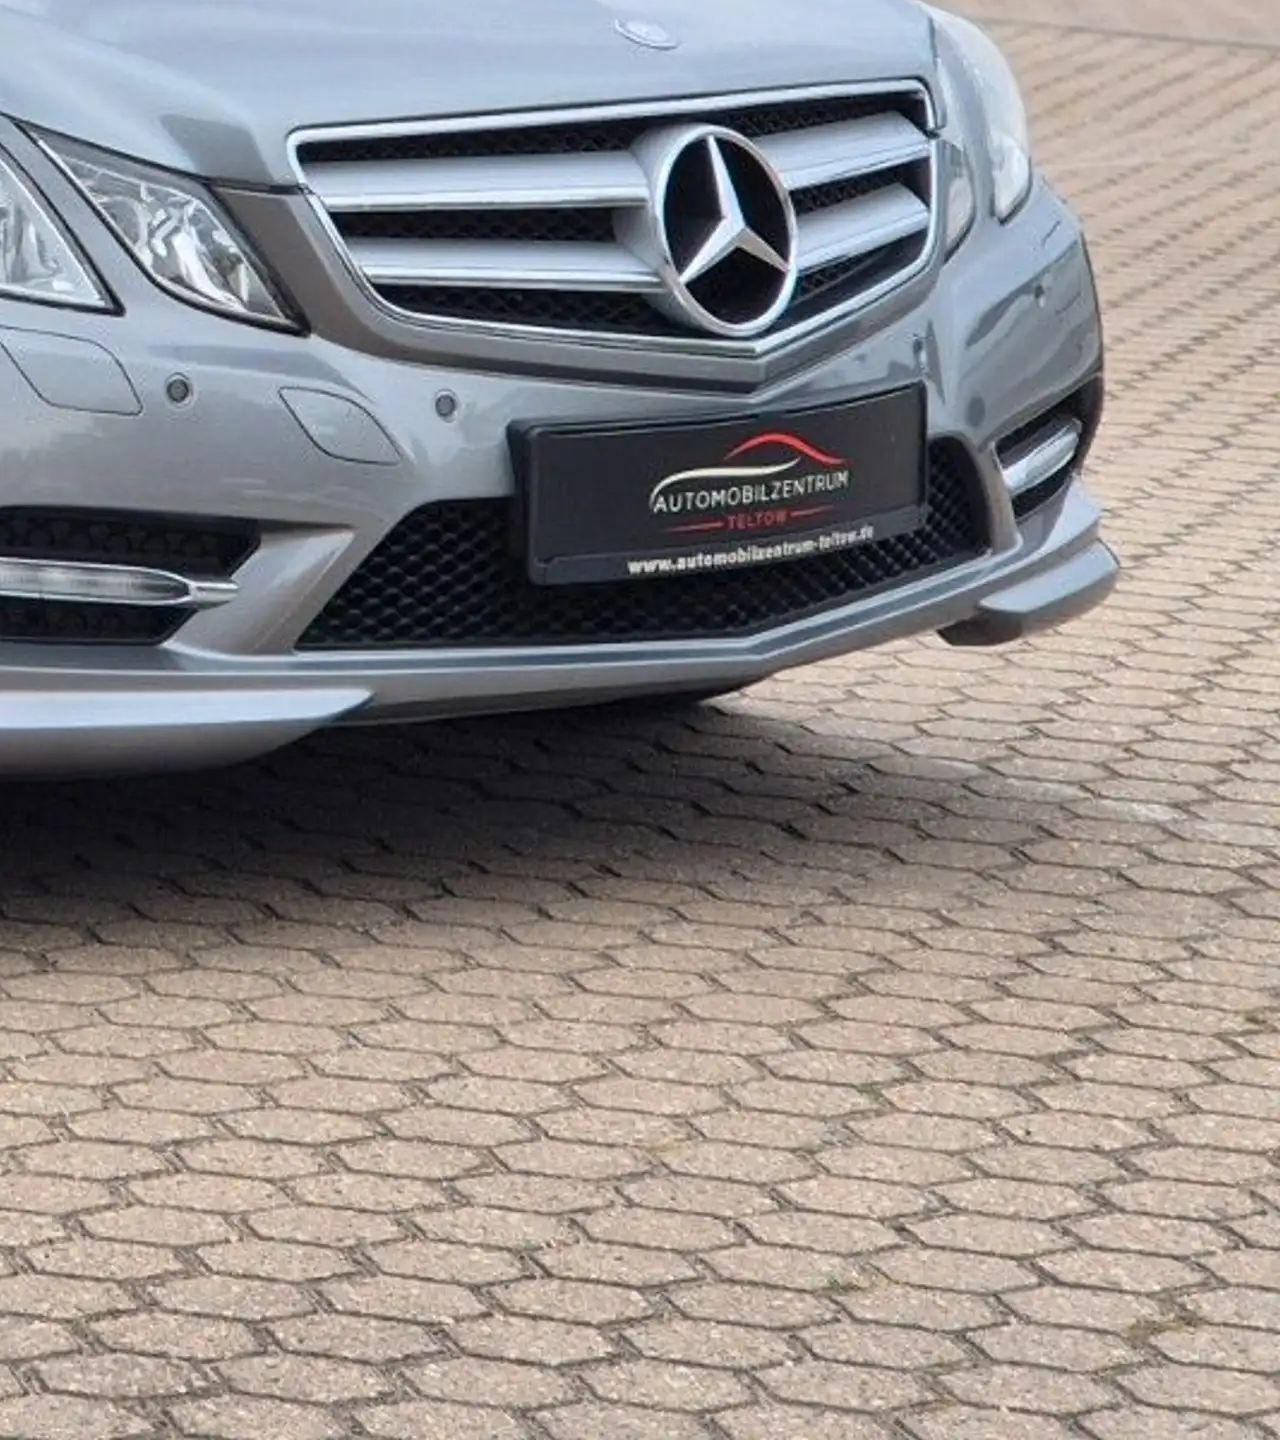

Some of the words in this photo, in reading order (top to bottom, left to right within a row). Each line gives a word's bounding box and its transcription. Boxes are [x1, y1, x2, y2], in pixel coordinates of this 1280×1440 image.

[652, 470, 850, 514] AUTOMOBILZENTRUM
[727, 511, 788, 531] TELTOW
[626, 523, 876, 575] www.automobilzentrum-teltow.de
